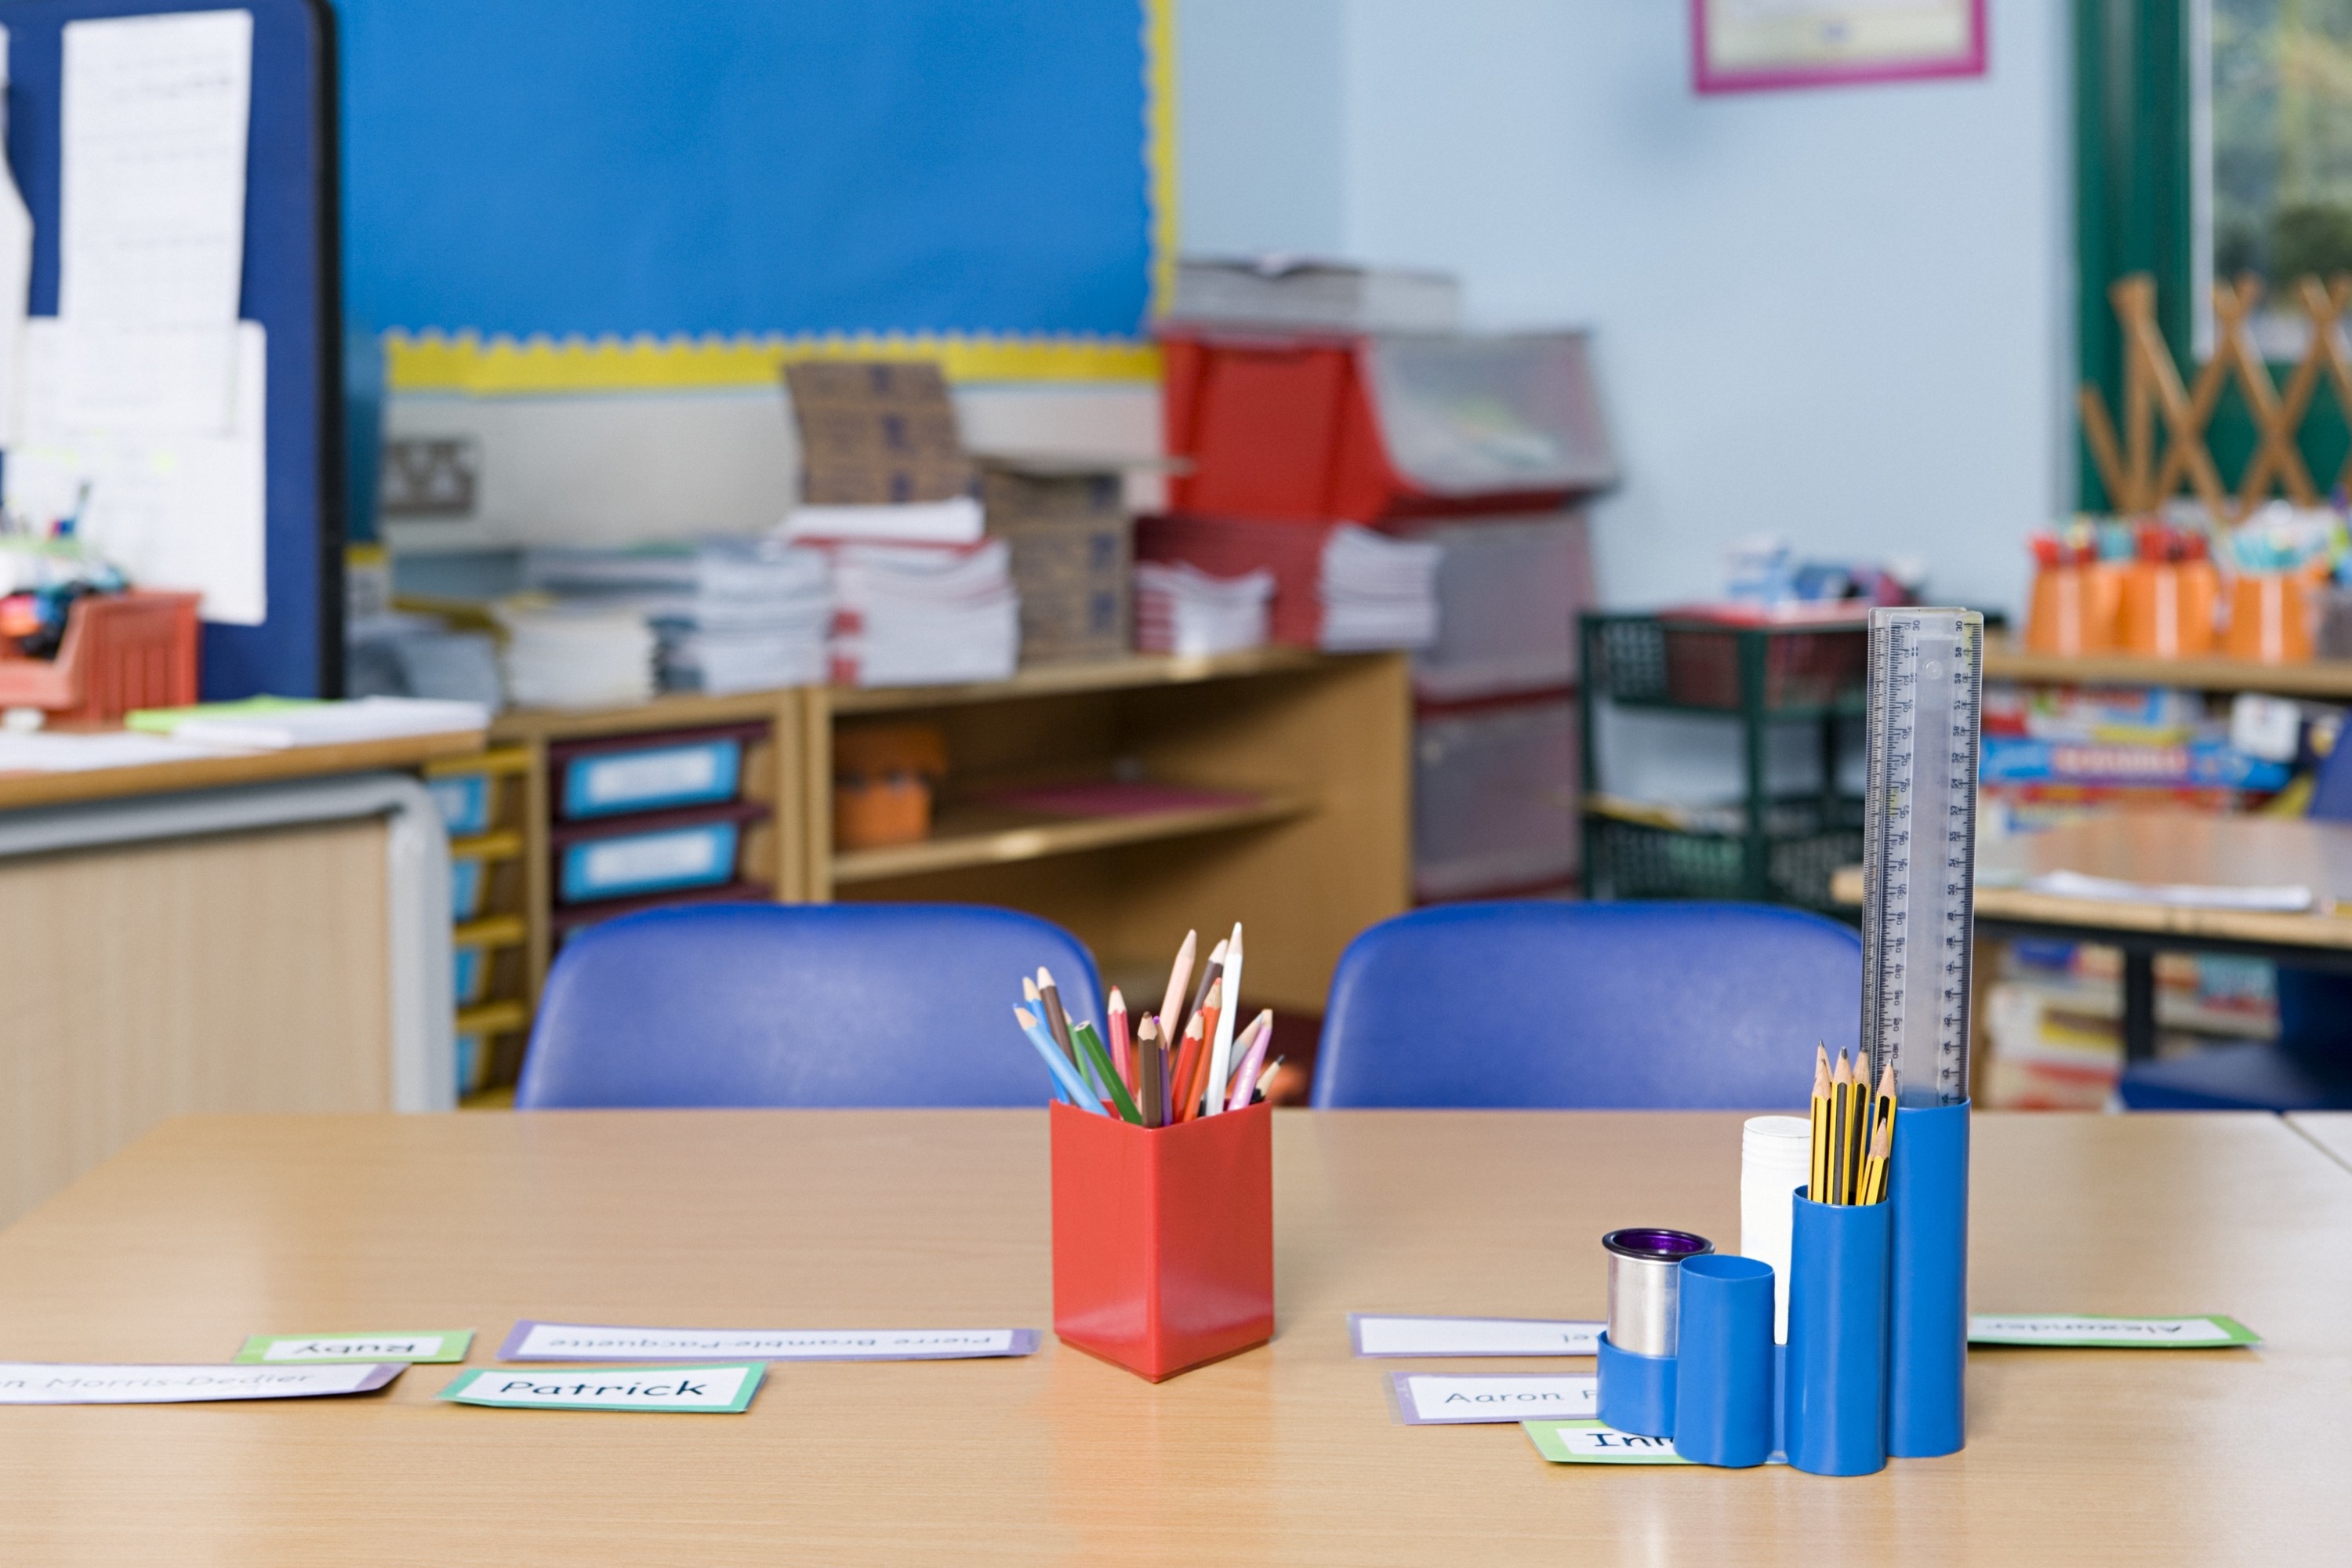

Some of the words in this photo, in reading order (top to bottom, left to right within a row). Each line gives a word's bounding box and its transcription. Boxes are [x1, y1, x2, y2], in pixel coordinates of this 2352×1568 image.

[1913, 620, 1920, 630] 30
[894, 1336, 991, 1345] Pierre
[294, 1342, 416, 1354] Ruby
[500, 1380, 708, 1396] Patrick
[1445, 1390, 1565, 1403] Aaron
